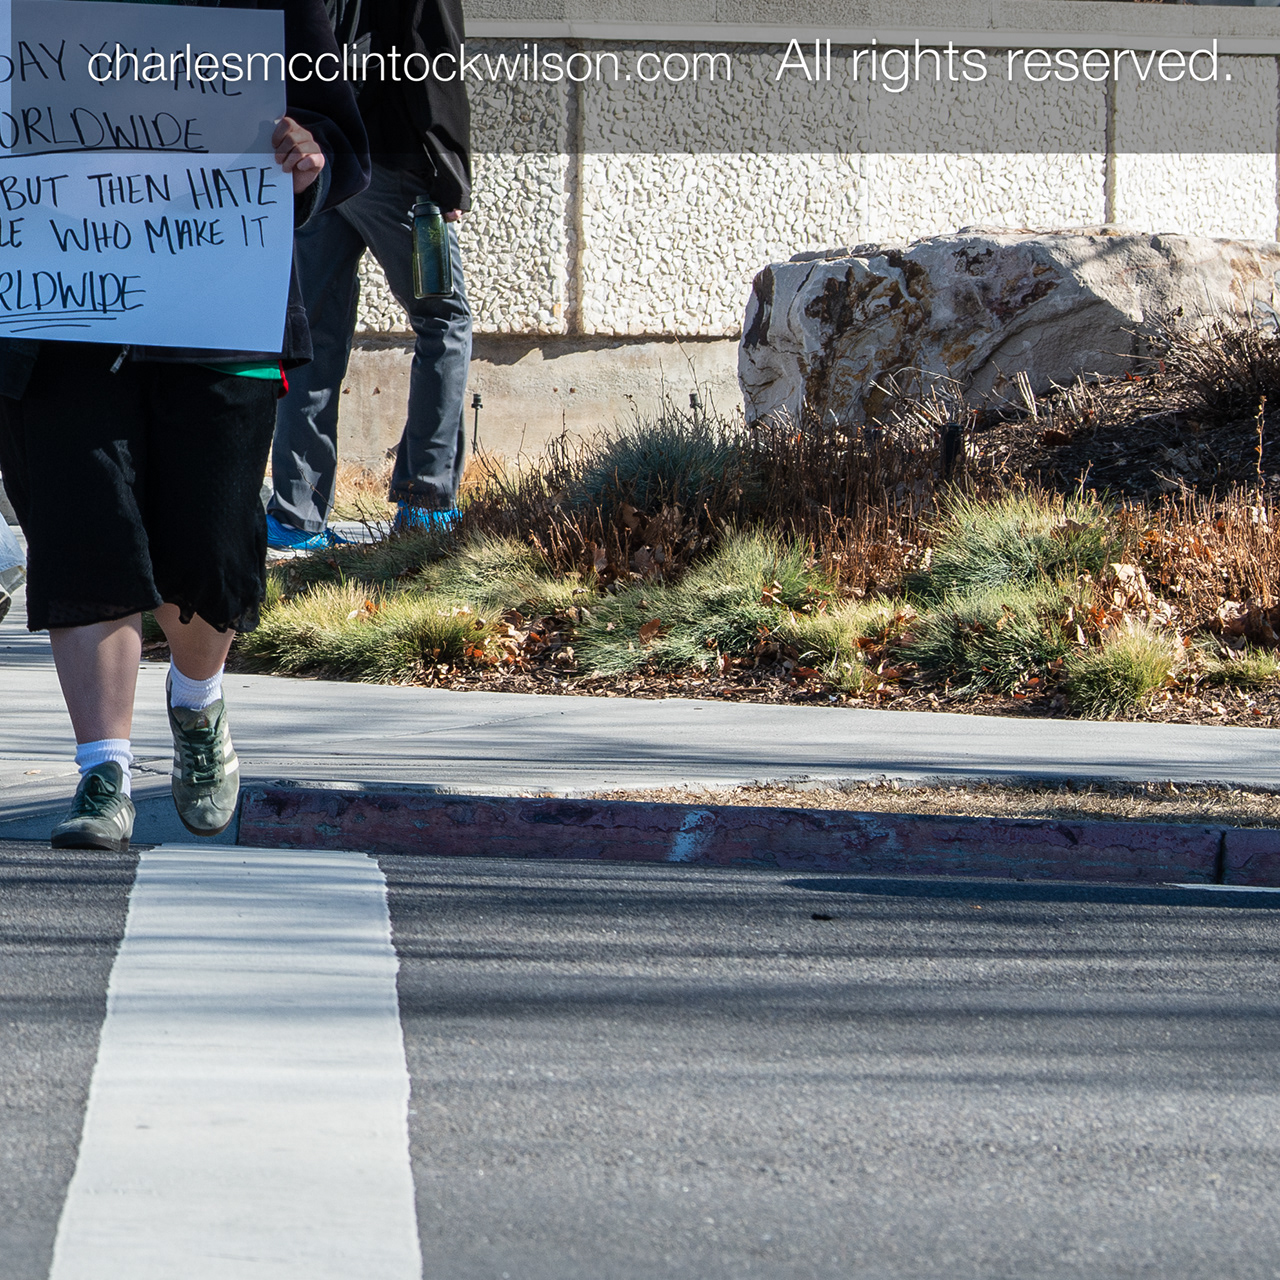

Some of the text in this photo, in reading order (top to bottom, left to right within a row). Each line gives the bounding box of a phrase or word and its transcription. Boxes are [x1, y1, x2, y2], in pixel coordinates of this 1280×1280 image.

[0, 174, 69, 210] BUT
[87, 172, 171, 208] THEN
[186, 166, 278, 210] HATE
[50, 218, 131, 254] WHO
[146, 215, 225, 255] MAKE
[242, 215, 270, 249] IT
